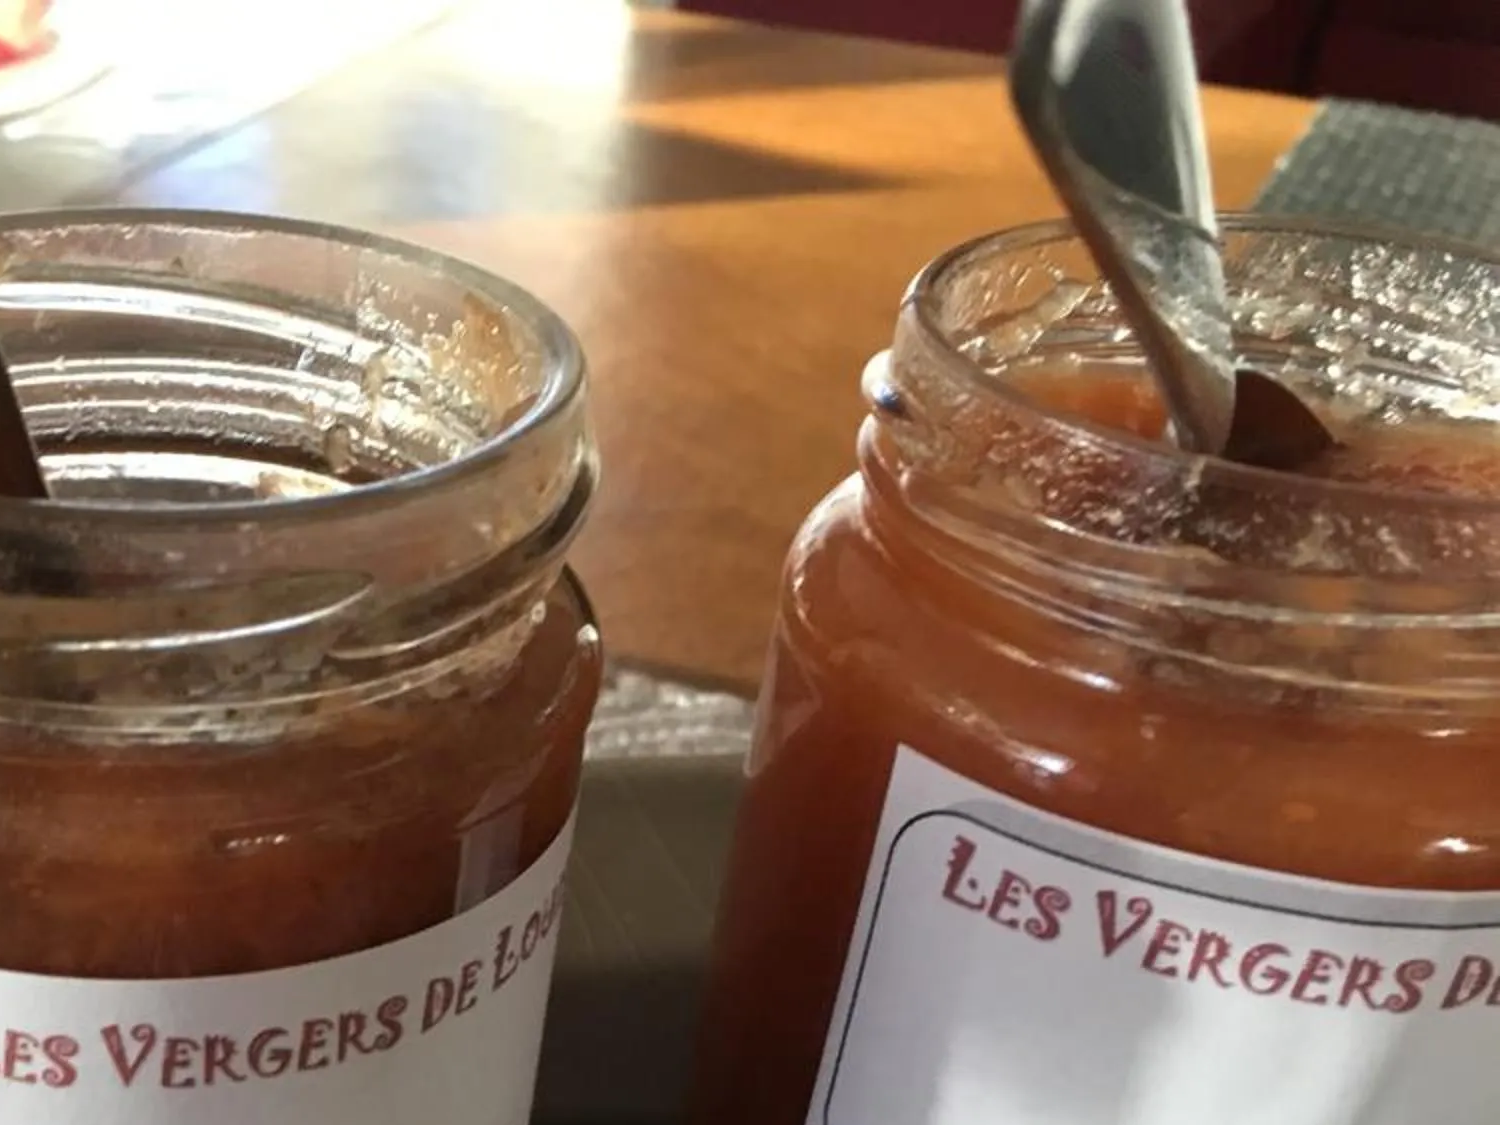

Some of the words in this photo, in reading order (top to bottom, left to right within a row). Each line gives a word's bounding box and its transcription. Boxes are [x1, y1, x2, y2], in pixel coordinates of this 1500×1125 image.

[100, 994, 408, 1089] VERGERS
[420, 959, 482, 1033] DE
[492, 870, 566, 992] LOU
[941, 835, 1072, 941] LES
[1094, 889, 1436, 1013] VERGERS
